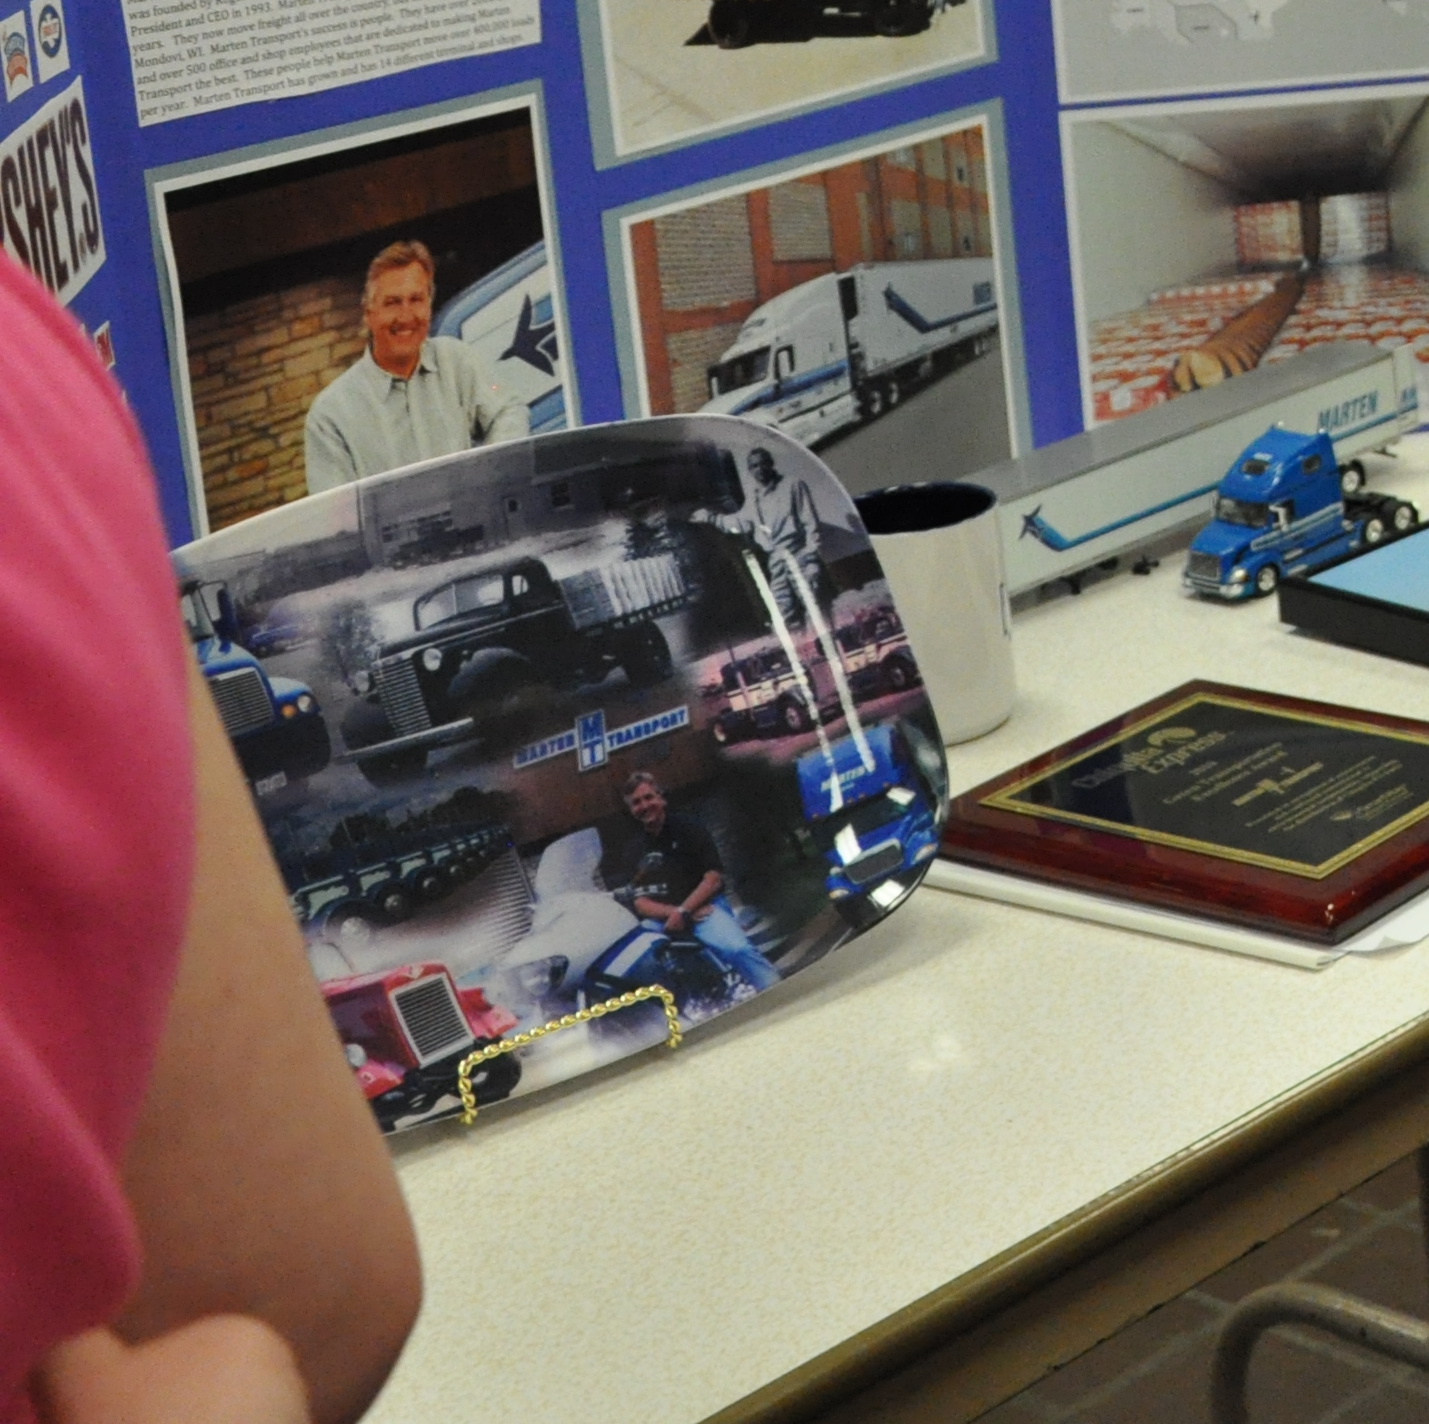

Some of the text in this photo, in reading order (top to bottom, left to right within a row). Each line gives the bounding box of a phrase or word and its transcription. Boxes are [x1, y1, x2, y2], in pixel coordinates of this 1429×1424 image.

[129, 10, 150, 19] was
[153, 0, 196, 15] founded
[131, 20, 181, 34] President
[185, 13, 204, 26] and
[207, 9, 229, 22] CEO
[232, 9, 241, 18] in
[245, 2, 270, 15] 1993.
[134, 40, 164, 51] years.
[172, 33, 198, 44] They
[201, 29, 223, 39] now
[227, 23, 254, 34] move
[257, 16, 290, 28] freight
[294, 11, 305, 22] all
[308, 9, 330, 19] over
[332, 6, 348, 15] the
[135, 53, 184, 66] Mondovi,
[210, 41, 247, 53] Marten
[138, 71, 156, 83] and
[159, 69, 183, 80] over
[186, 62, 205, 75] 500
[209, 58, 237, 70] office
[240, 52, 258, 64] and
[261, 49, 285, 59] shop
[289, 39, 340, 54] employees
[343, 34, 362, 44] that
[365, 31, 380, 40] are
[139, 83, 191, 98] Transport
[195, 79, 211, 89] the
[243, 67, 273, 79] These
[276, 59, 310, 75] people
[313, 55, 333, 65] help
[336, 48, 370, 60] Marten
[141, 106, 157, 116] per
[192, 92, 230, 104] Marten
[233, 80, 284, 96] Transport
[287, 78, 305, 86] has
[308, 70, 337, 85] grown
[340, 64, 357, 76] and
[1317, 390, 1378, 432] MARTEN
[516, 733, 575, 764] MARTEN
[607, 709, 686, 749] TRANSPORT
